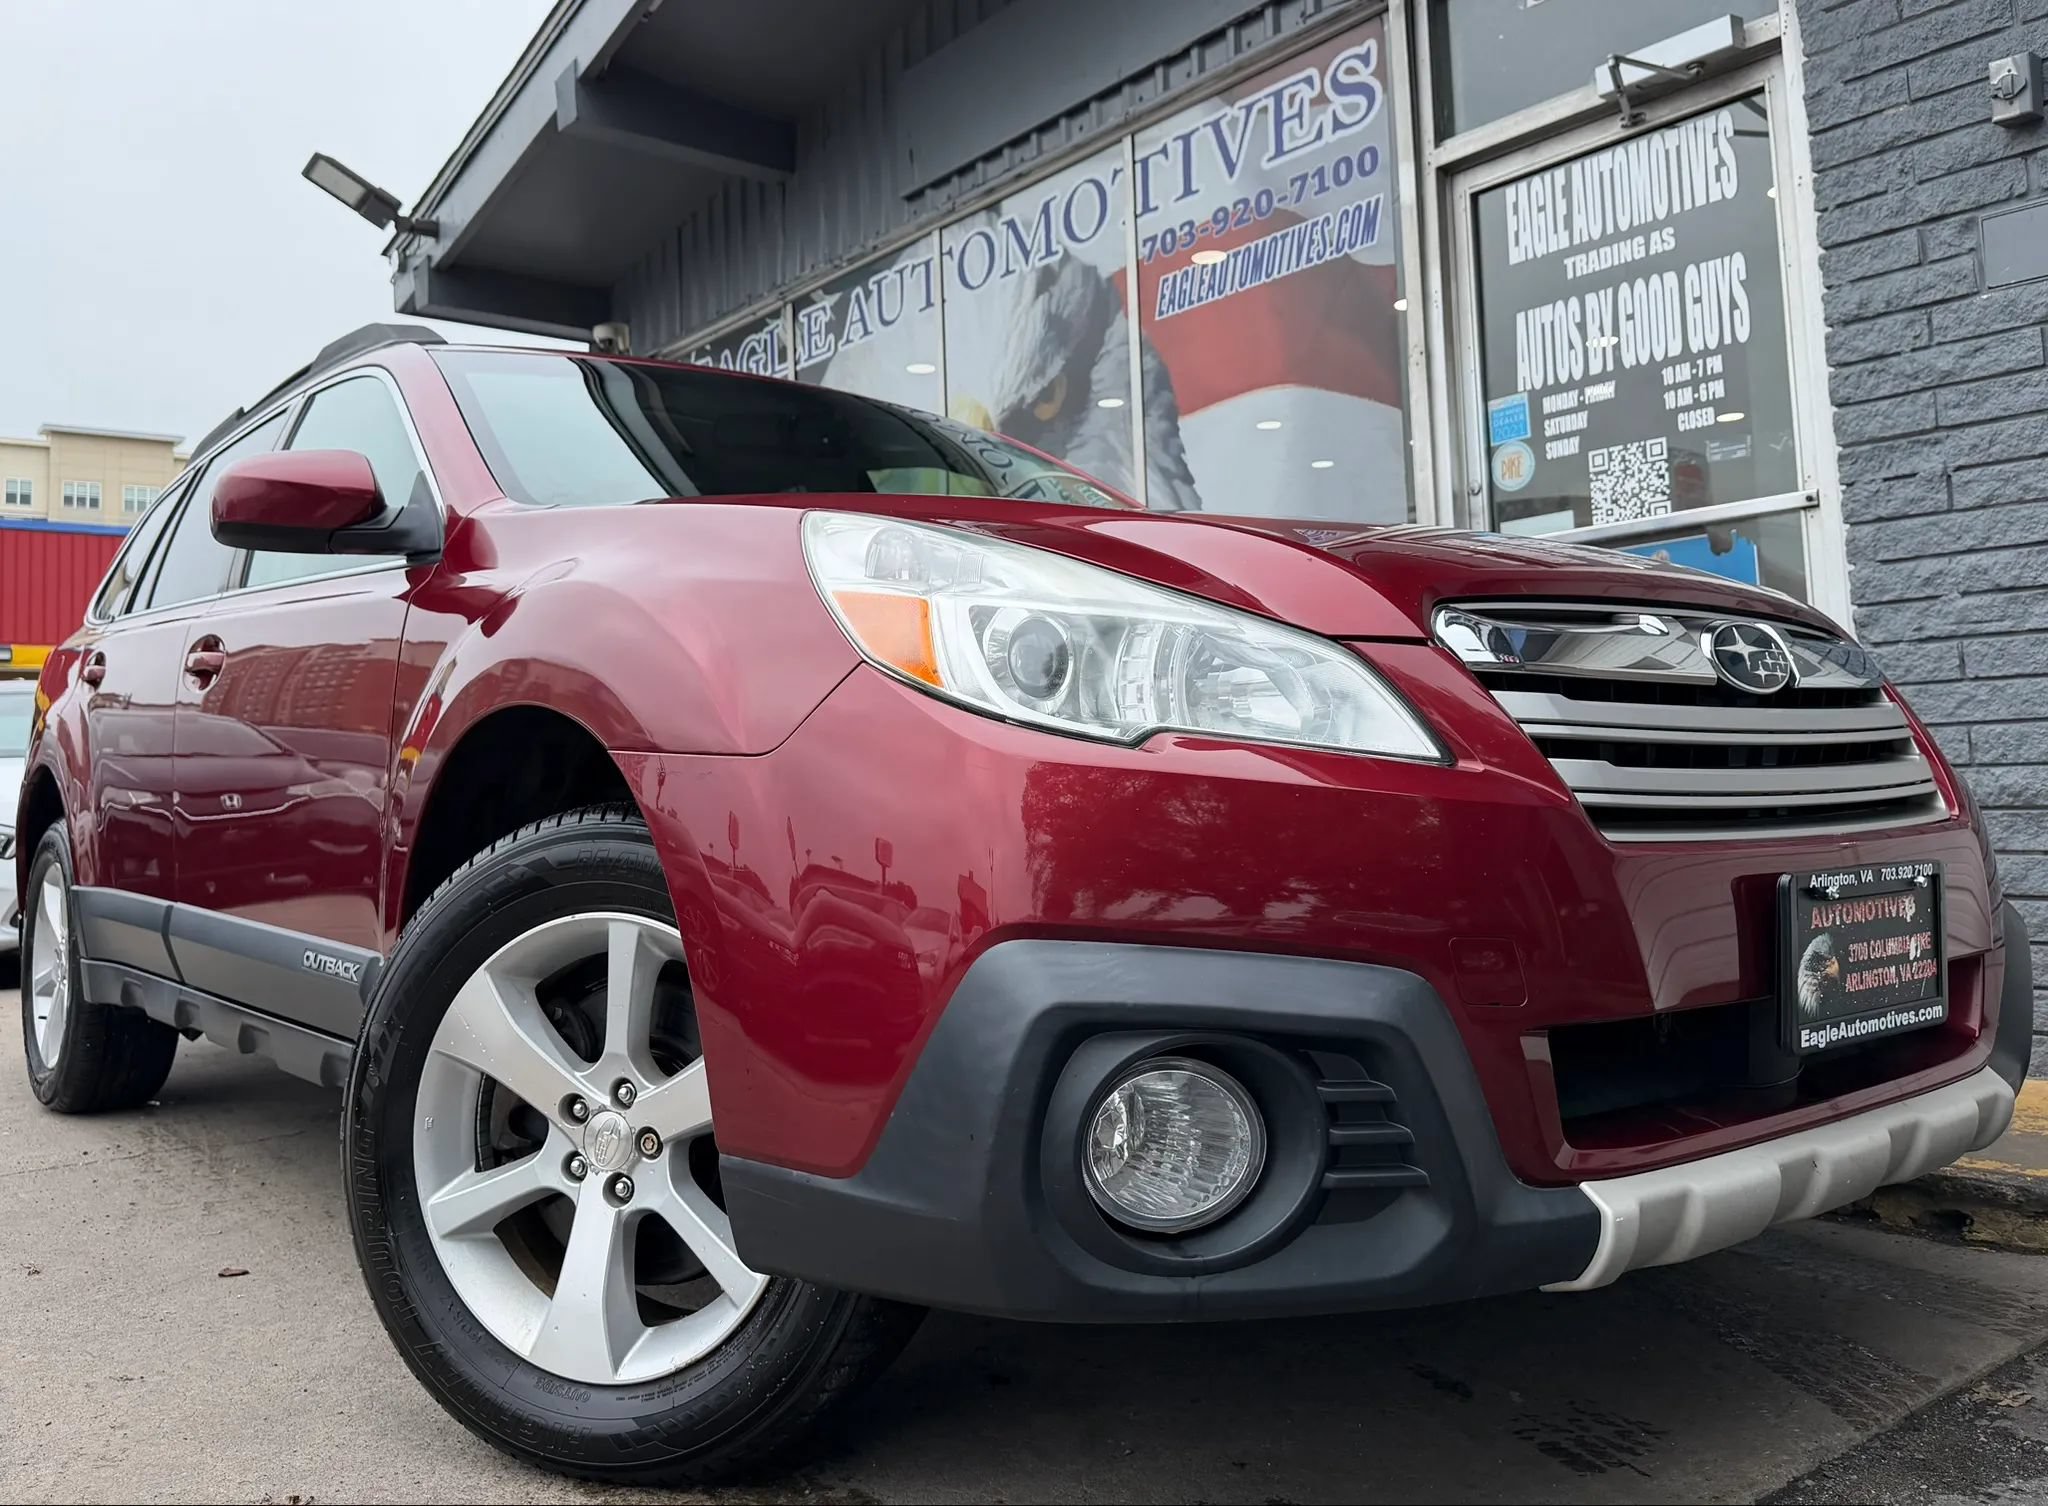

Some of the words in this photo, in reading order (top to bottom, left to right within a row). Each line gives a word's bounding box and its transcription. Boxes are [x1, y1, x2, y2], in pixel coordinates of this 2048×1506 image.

[839, 37, 1383, 349] AUTOMOTIVES
[1506, 166, 1570, 265] EAGLE
[1573, 110, 1738, 244] AUTOMOTIVES
[1142, 146, 1380, 263] 703-920-7100
[1155, 194, 1383, 320] EAGLEAUTOMOTIVES.COM
[1563, 238, 1645, 280] TRADING
[1649, 226, 1676, 256] AS
[1515, 296, 1583, 392] AUTOS
[1584, 286, 1614, 377] BY
[1618, 270, 1682, 370] GOOD
[1684, 251, 1751, 354] GUYS
[1661, 367, 1674, 386] 10
[1675, 362, 1691, 383] AM
[1697, 359, 1703, 378] 7
[1706, 354, 1723, 375] PM
[1543, 389, 1579, 414] MONDAY
[1664, 390, 1676, 410] 10
[1677, 386, 1693, 407] AM
[1699, 382, 1707, 402] 6
[1708, 379, 1725, 400] PM
[1544, 411, 1588, 437] SATURDAY
[1677, 407, 1715, 432] CLOSED
[1545, 436, 1580, 460] SUNDAY
[1810, 872, 1858, 889] Arlington,
[1860, 870, 1874, 883] VA
[1881, 863, 1933, 881] 703.920.7100
[303, 950, 360, 982] OUTBACK
[1800, 1004, 1943, 1049] EagleAutomotives.com
